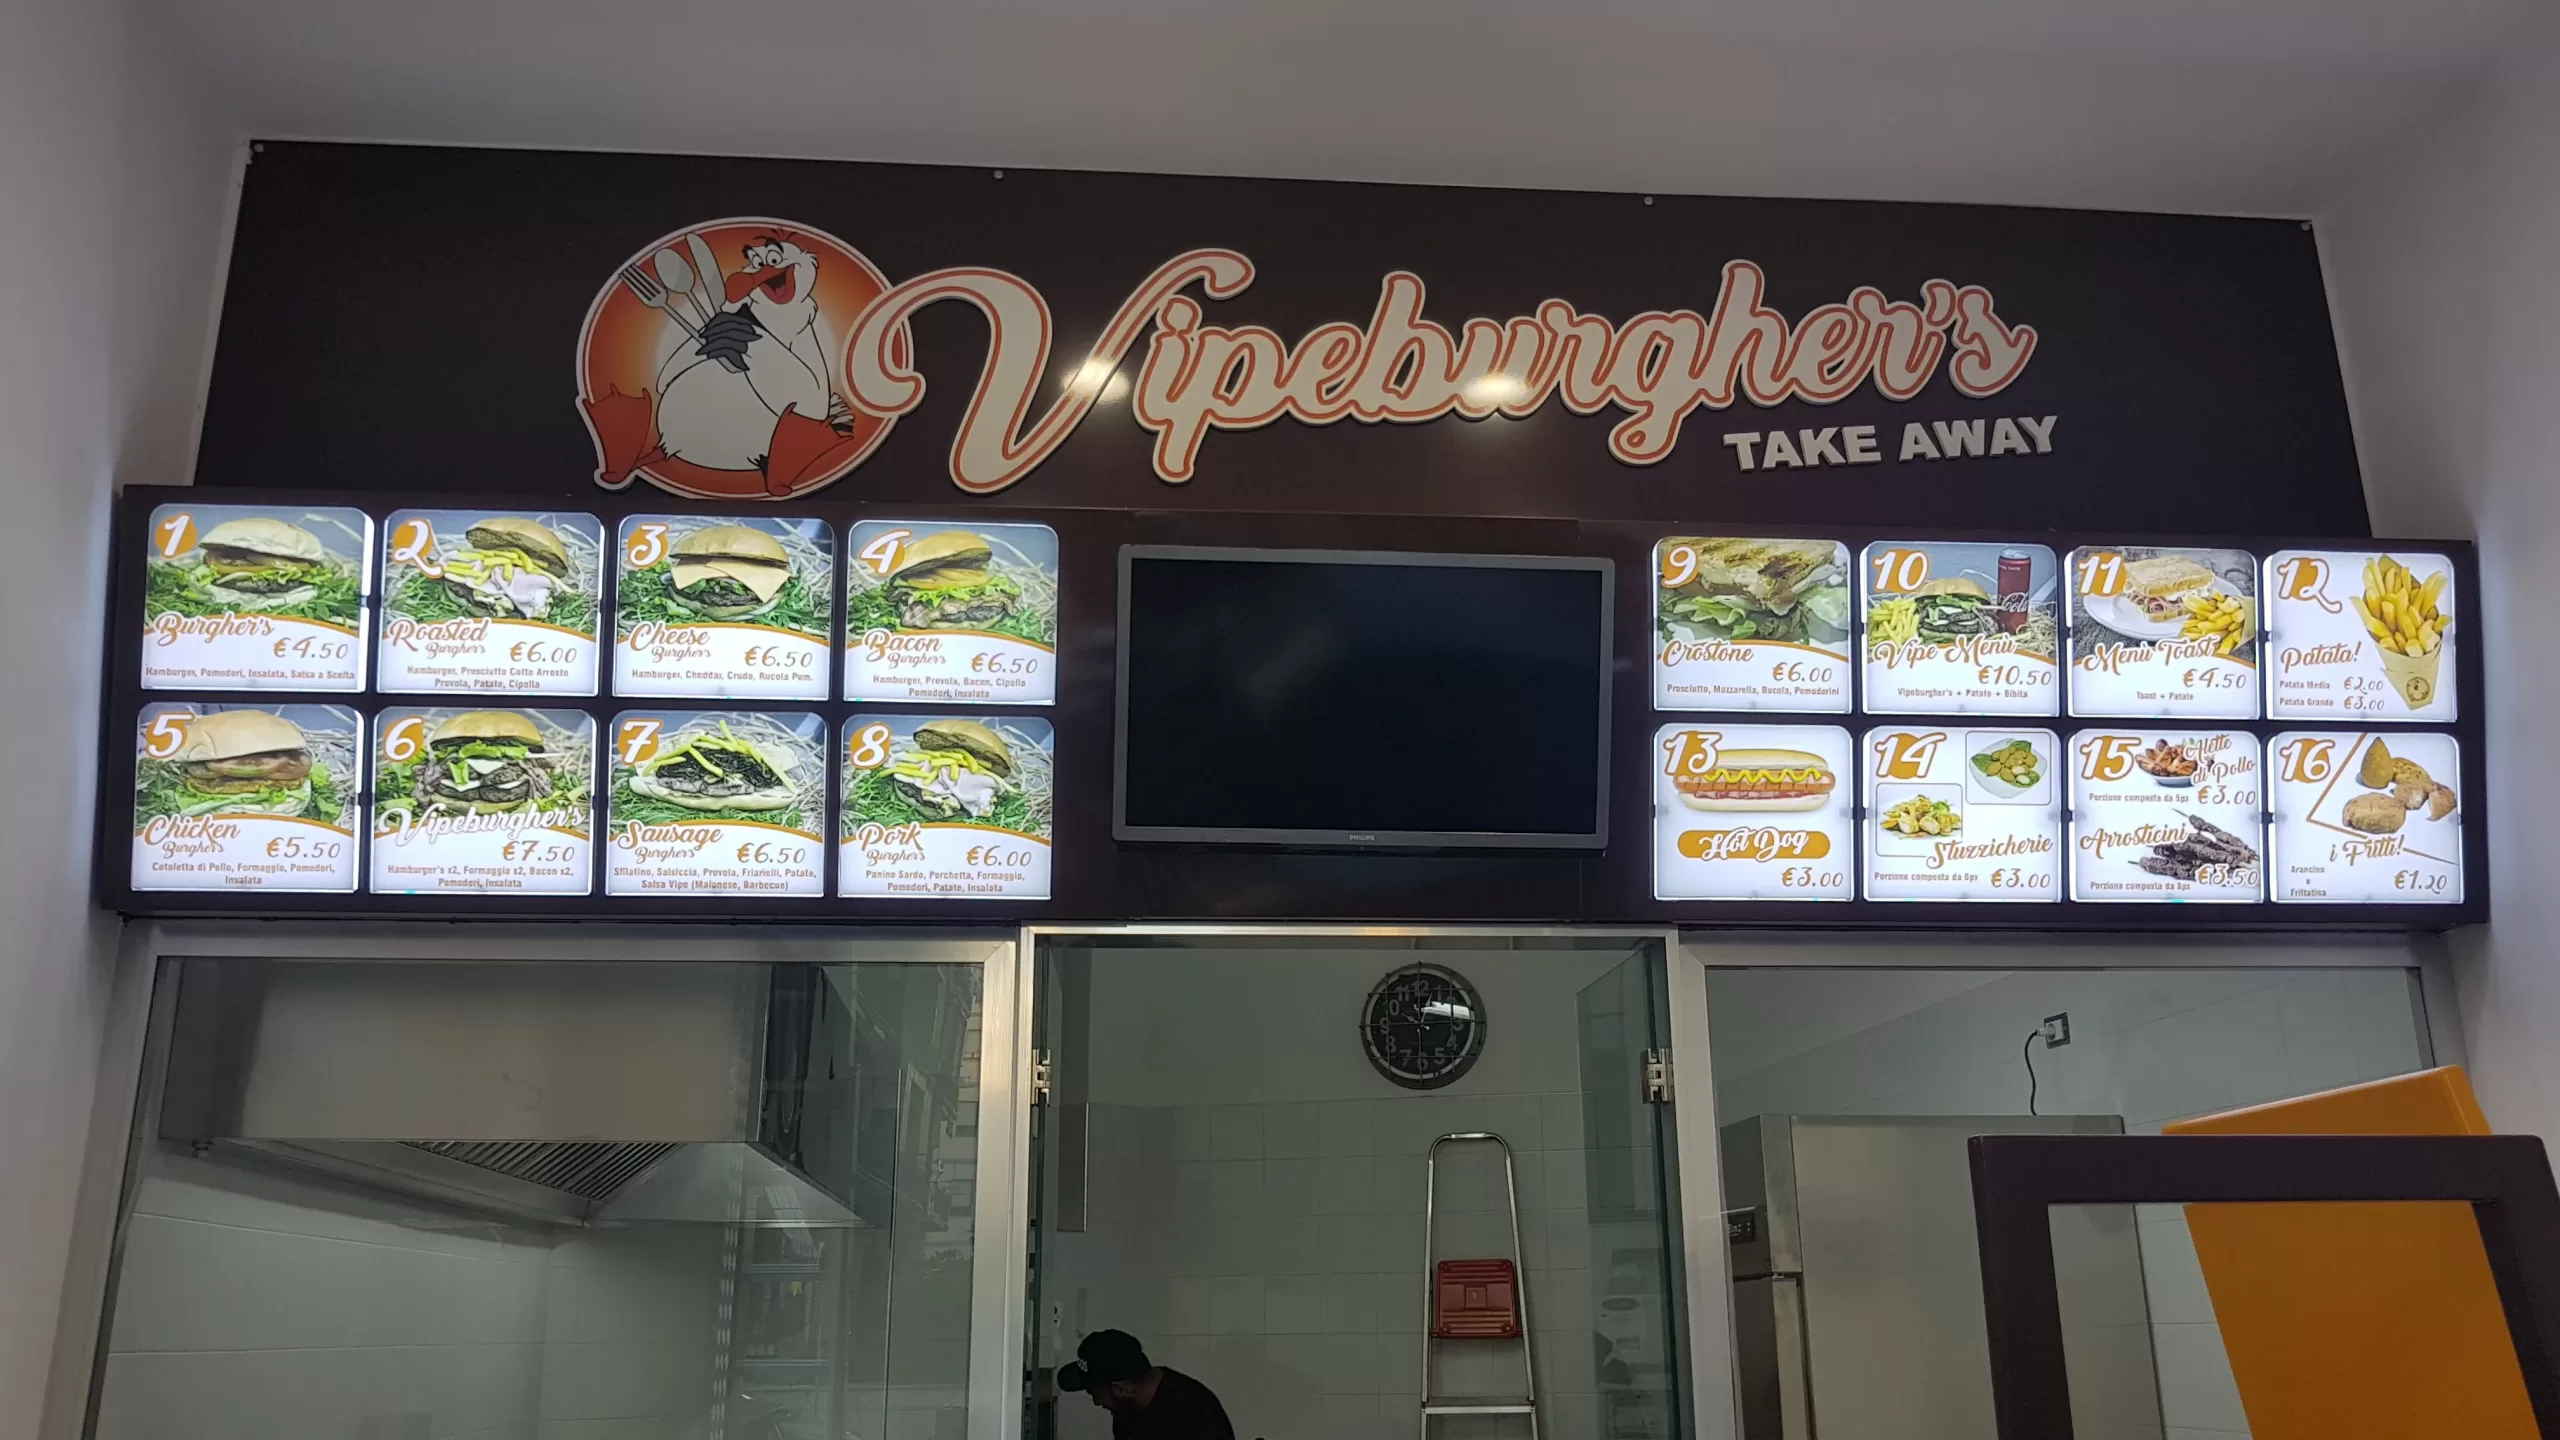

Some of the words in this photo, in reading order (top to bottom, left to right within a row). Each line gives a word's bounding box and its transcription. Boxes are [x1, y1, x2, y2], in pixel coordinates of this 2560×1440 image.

[842, 248, 2038, 493] Vipeburgher's
[1723, 426, 1882, 471] TAKE
[1899, 415, 2058, 462] AWAY
[161, 513, 192, 557] 1
[628, 524, 670, 568] 3
[391, 520, 445, 578] 2
[859, 529, 911, 575] 4
[1662, 546, 1698, 588] 9
[1873, 549, 1929, 592] 10
[2078, 554, 2126, 597] 11
[2277, 557, 2342, 614] 12
[155, 613, 274, 646] Burgher's
[389, 618, 489, 652] Roasted
[630, 623, 710, 651] Cheese
[273, 636, 348, 658] €4.50
[425, 641, 485, 660] Burgher's
[510, 642, 577, 662] €6.00
[651, 646, 711, 663] Burgher's
[745, 645, 813, 667] €6.50
[865, 630, 942, 662] Bacon
[1663, 640, 1753, 667] Crostone
[1874, 639, 1938, 669] Vipe
[1944, 635, 2016, 666] Menù
[2084, 642, 2153, 675] Menù
[2157, 636, 2221, 666] Toast
[887, 652, 946, 669] Burgher's
[972, 652, 1038, 674] €6.50
[2281, 641, 2362, 674] Patata!
[146, 668, 197, 677] Hamburger,
[200, 668, 245, 678] Pomodori,
[249, 669, 287, 678] Insalata,
[292, 669, 315, 678] Salsa
[326, 670, 354, 679] Scelta
[408, 666, 458, 676] Hamburger,
[461, 667, 506, 676] Prosciutto
[510, 668, 533, 676] Cotto
[536, 668, 568, 676] Arrosto
[632, 670, 682, 679] Hamburger,
[686, 671, 724, 680] Cheddar,
[728, 672, 756, 680] Crudo,
[759, 672, 788, 680] Rucola
[873, 675, 923, 685] Hamburger,
[926, 676, 960, 686] Provola,
[964, 678, 992, 687] Bacon,
[996, 679, 1026, 687] Cipolla
[1773, 662, 1832, 682] €6.00
[1978, 665, 2052, 685] €10.50
[2183, 668, 2247, 688] €4.50
[435, 679, 470, 688] Provola,
[474, 679, 505, 688] Patate,
[509, 680, 540, 689] Cipolla
[909, 688, 952, 698] Pomodori,
[955, 689, 989, 698] Insalata
[1667, 684, 1711, 694] Prosciutto,
[1714, 685, 1759, 695] Mozzarella,
[1762, 686, 1792, 695] Rucola,
[1794, 687, 1839, 695] Pomodorini
[1898, 688, 1952, 697] Vipeburgher's
[1966, 689, 1991, 697] Patate
[2005, 690, 2028, 698] Bibita
[2280, 681, 2304, 689] Patata
[2307, 681, 2330, 689] Media
[2344, 677, 2384, 695] €2.00
[2137, 692, 2156, 700] Toast
[2169, 692, 2193, 700] Patate
[2280, 698, 2304, 706] Patata
[2307, 698, 2333, 706] Grande
[2344, 696, 2385, 710] €3.00
[145, 713, 195, 758] 5
[384, 717, 424, 761] 6
[621, 720, 663, 766] 7
[853, 722, 891, 769] 8
[1663, 731, 1722, 776] 13
[1875, 732, 1947, 778] 14
[2080, 736, 2142, 781] 15
[2183, 734, 2232, 764] Alette
[2192, 769, 2208, 785] di
[2212, 756, 2256, 784] Pollo
[2280, 738, 2336, 783] 16
[2089, 793, 2122, 801] Porzione
[2124, 794, 2161, 802] composta
[2164, 794, 2173, 802] da
[2198, 785, 2256, 804] €3.00
[144, 815, 240, 846] Chicken
[378, 803, 586, 846] Vipeburgher's
[618, 821, 723, 851] Sausage
[858, 822, 924, 851] Pork
[1699, 826, 1755, 861] Hot
[1754, 826, 1809, 862] Dog
[2080, 823, 2189, 859] Arrosticini
[162, 841, 224, 859] Burgher's
[266, 837, 341, 858] €5.50
[503, 841, 575, 862] €7.50
[635, 847, 696, 864] Burgher's
[737, 842, 805, 863] €6.50
[866, 849, 926, 866] Burgher's
[966, 845, 1032, 866] €6.00
[1926, 833, 2053, 869] Stuzzicherie
[2343, 835, 2405, 866] Fritti!
[153, 863, 194, 871] Cotoletta
[198, 863, 206, 871] di
[209, 863, 234, 872] Pollo,
[238, 864, 287, 873] Formaggio,
[290, 864, 335, 873] Pomodori,
[463, 866, 510, 876] Formaggio
[529, 867, 558, 876] Bacon
[614, 868, 654, 877] Sfilatino,
[657, 867, 700, 877] Salsiccia,
[703, 868, 739, 877] Provola,
[742, 869, 782, 878] Friarielli,
[785, 869, 817, 878] Patate,
[866, 870, 896, 878] Panino
[899, 870, 926, 879] Sardo,
[929, 871, 974, 880] Porchetta,
[977, 872, 1025, 881] Formaggio,
[1782, 867, 1843, 887] €3.00
[1875, 872, 1908, 880] Porzione
[1912, 873, 1949, 882] composta
[1952, 873, 1962, 881] da
[1991, 868, 2050, 888] €3.00
[2196, 864, 2259, 886] €3.50
[225, 876, 262, 884] Insalata
[438, 878, 483, 888] Pomodori,
[486, 879, 522, 888] Insalata
[642, 880, 666, 889] Salsa
[669, 880, 688, 889] Vipe
[692, 880, 741, 890] (Maionese,
[744, 880, 788, 890] Barbecue)
[888, 882, 931, 892] Pomodori,
[934, 883, 965, 892] Patate,
[968, 884, 1002, 892] Insalata
[2091, 882, 2123, 890] Porzione
[2126, 883, 2162, 891] composta
[2395, 870, 2447, 894] €1.20
[2291, 888, 2326, 897] Frittatina
